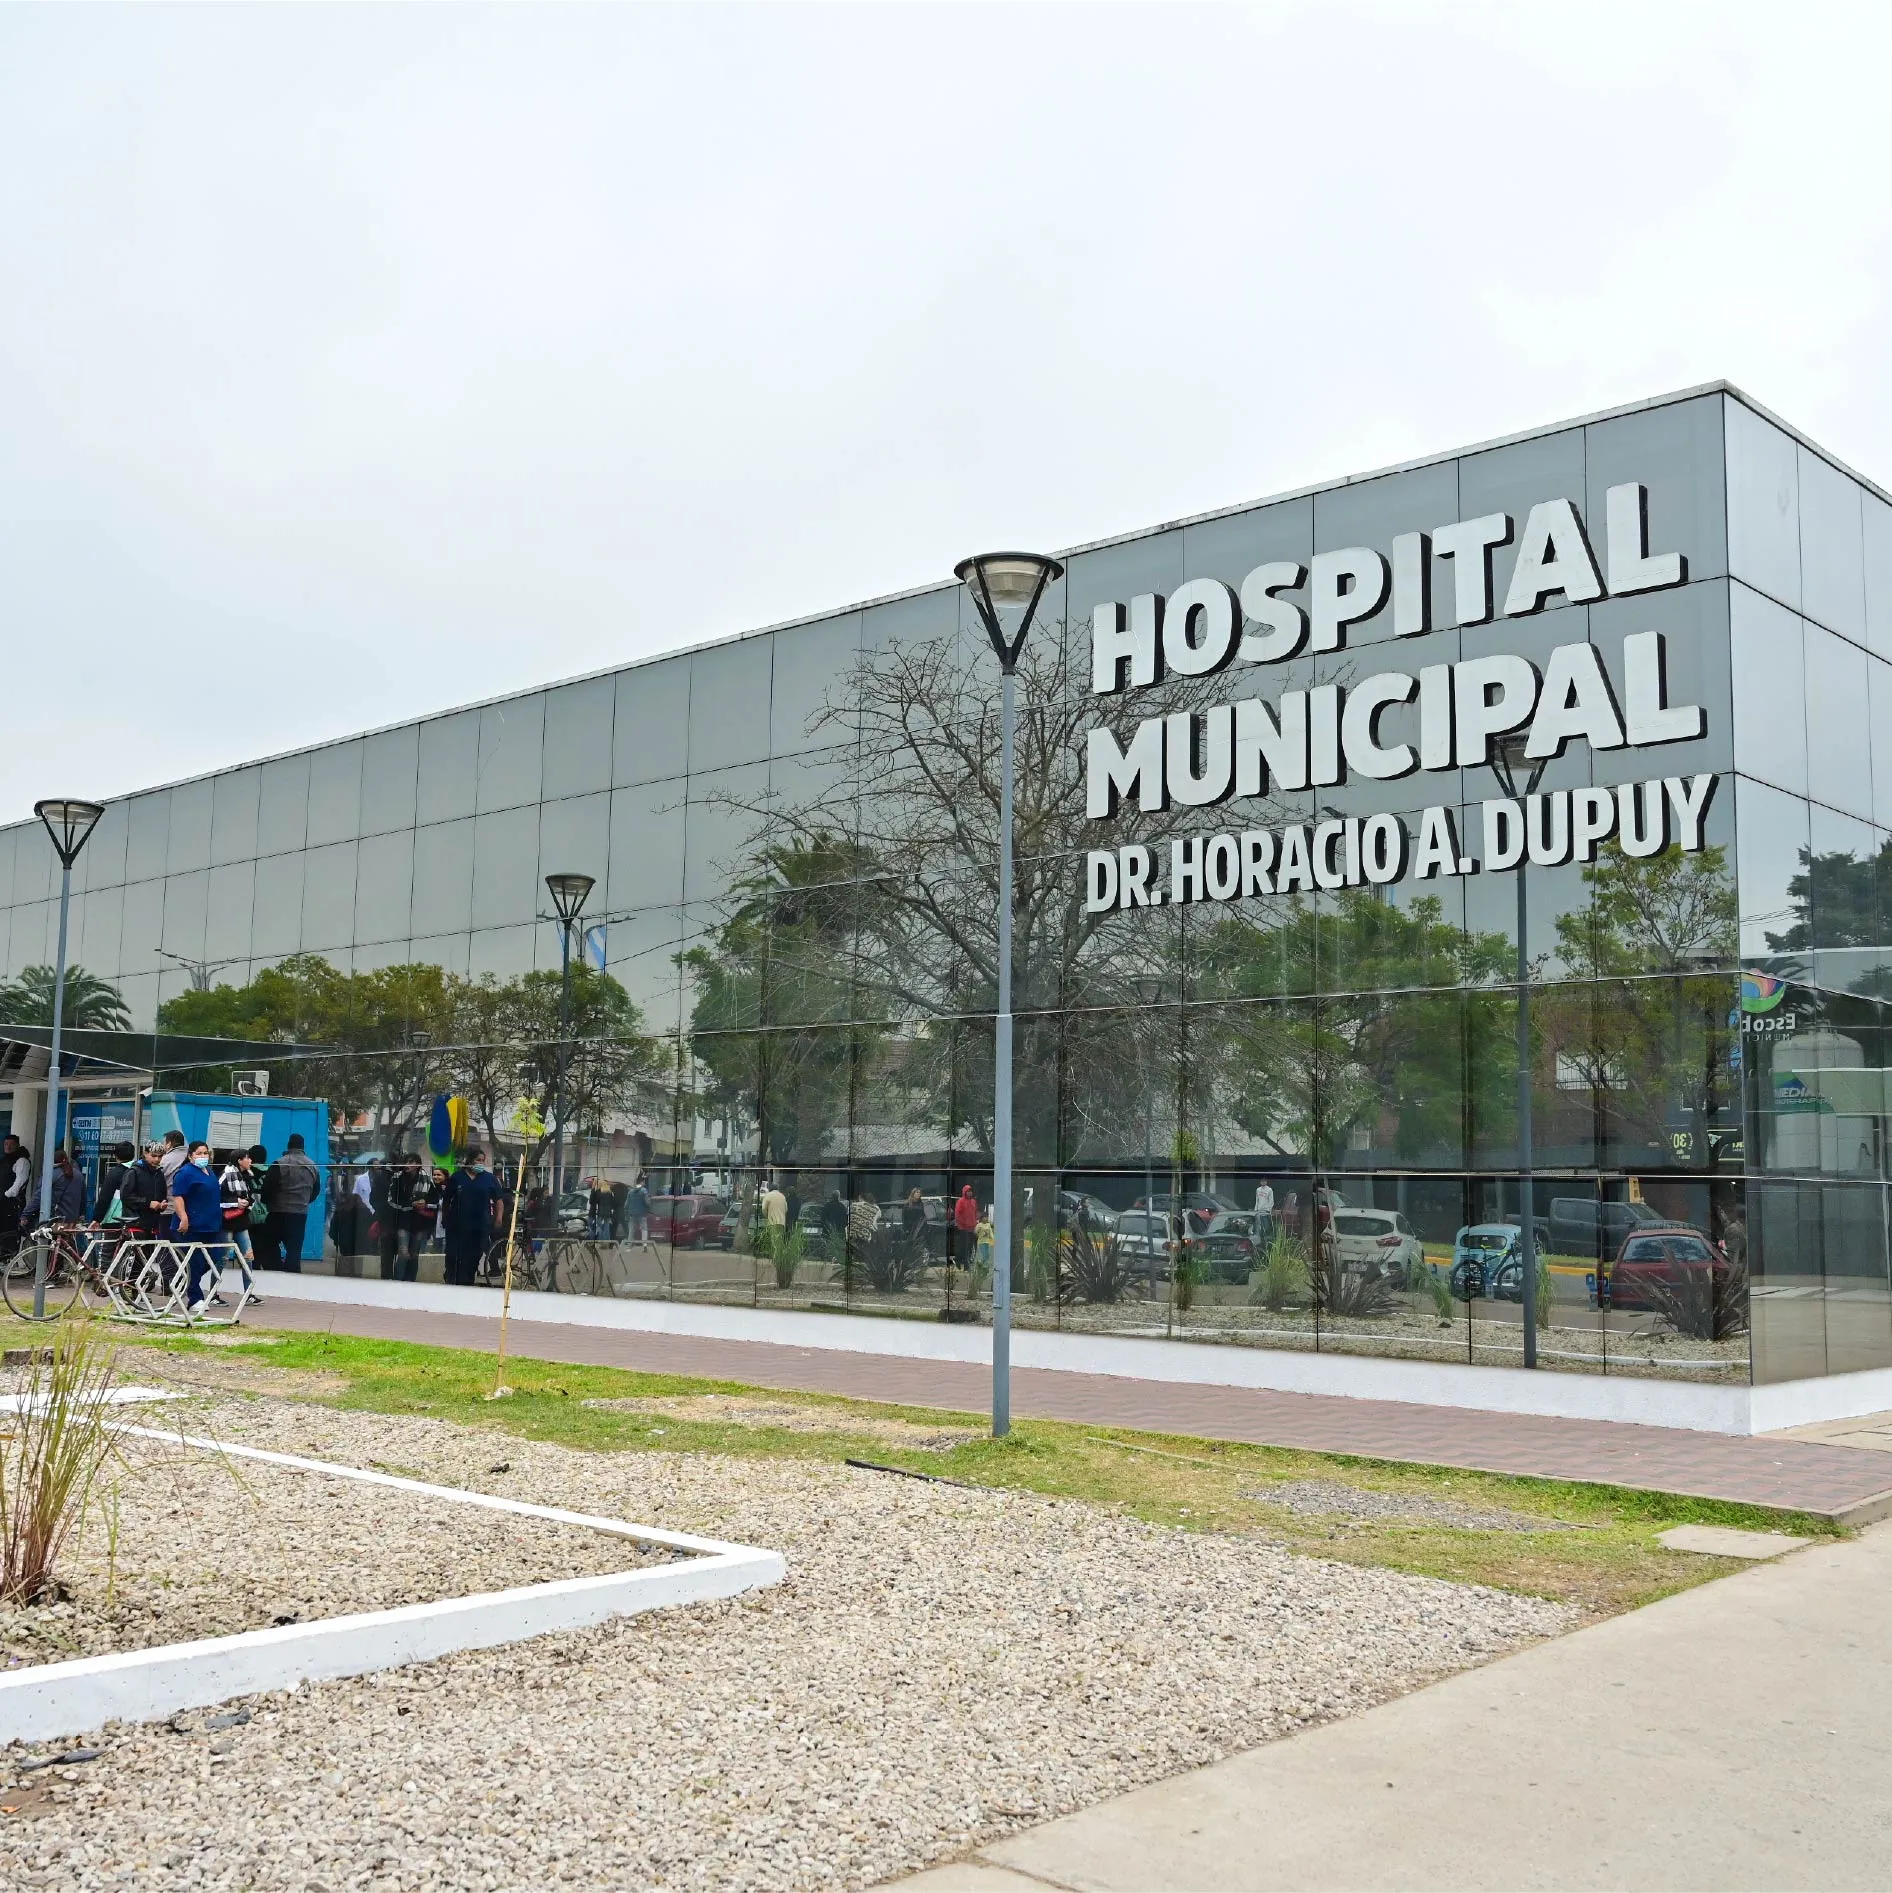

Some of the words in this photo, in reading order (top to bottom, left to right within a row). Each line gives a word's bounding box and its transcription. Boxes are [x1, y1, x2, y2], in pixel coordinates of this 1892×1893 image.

[1092, 481, 1688, 696] HOSPITAL
[1086, 630, 1707, 820] MUNICIPAL
[1170, 813, 1409, 905] HORACIO
[1482, 773, 1719, 872] DUPUY
